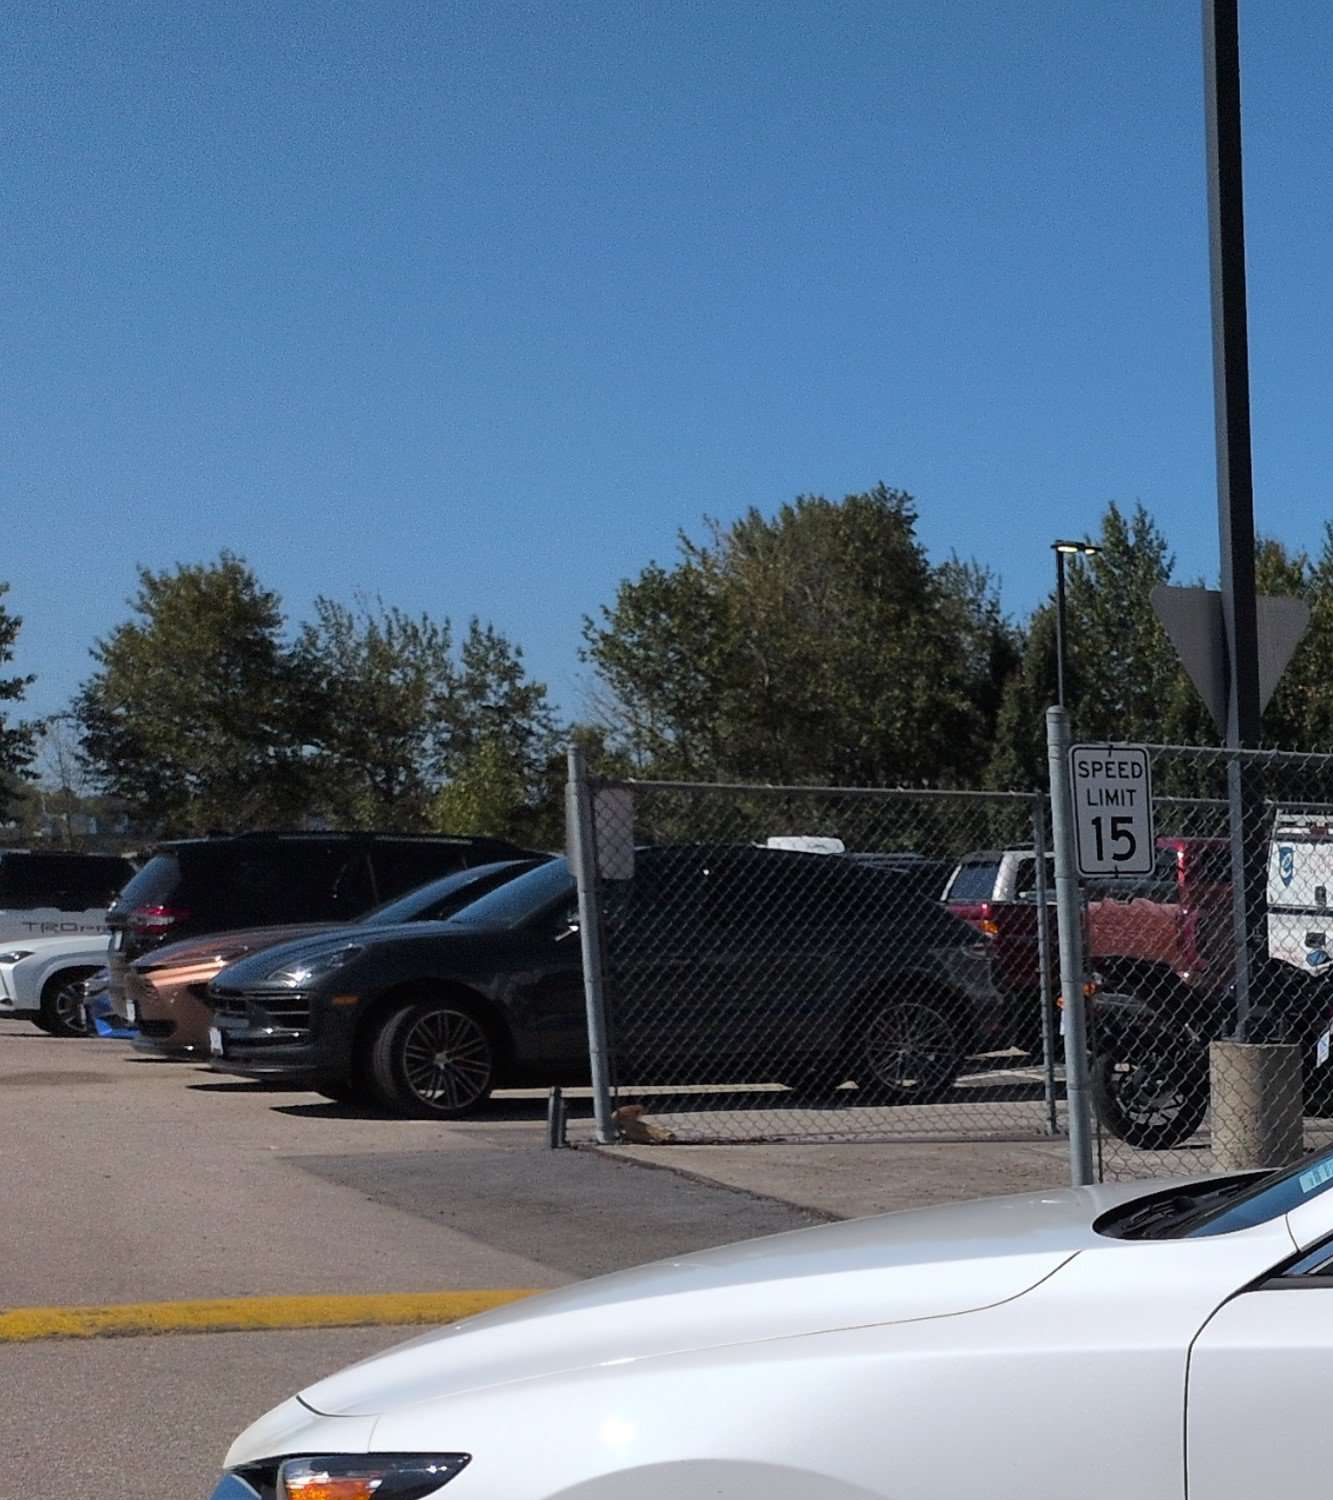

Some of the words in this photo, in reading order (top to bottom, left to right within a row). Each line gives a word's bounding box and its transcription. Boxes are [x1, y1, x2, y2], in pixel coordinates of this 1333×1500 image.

[1078, 761, 1143, 779] SPEED
[1086, 788, 1137, 807] LIMIT
[1091, 816, 1137, 862] 15
